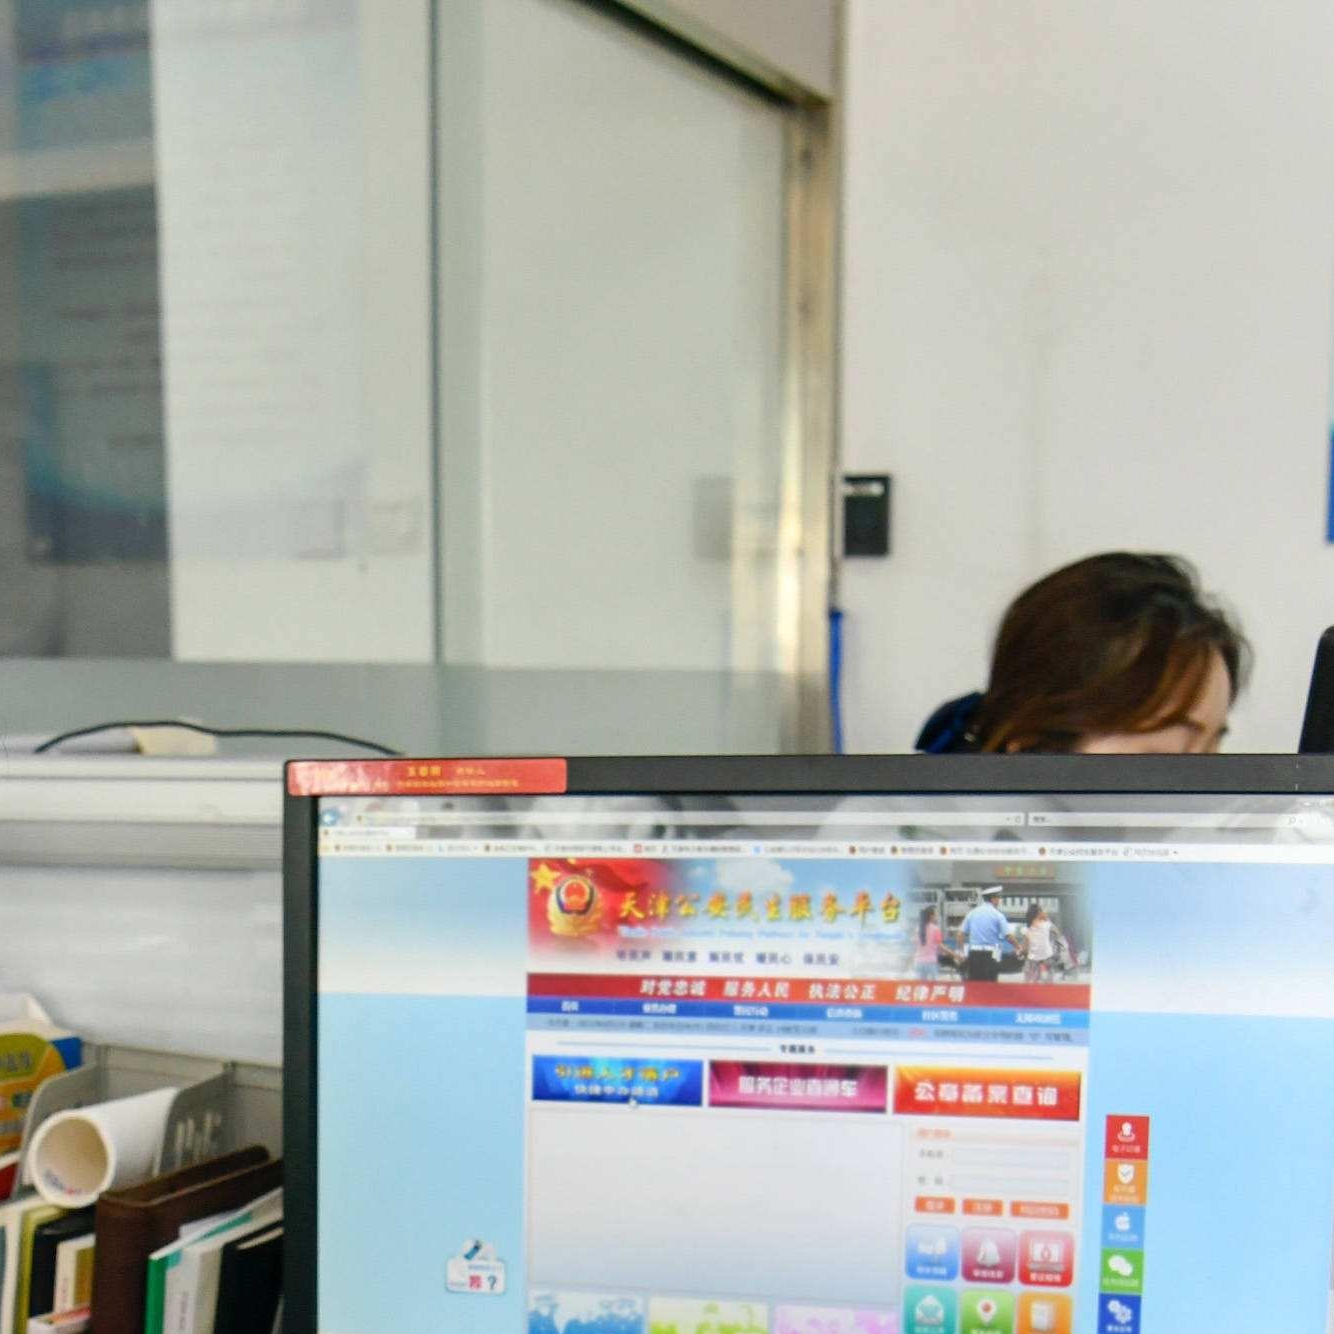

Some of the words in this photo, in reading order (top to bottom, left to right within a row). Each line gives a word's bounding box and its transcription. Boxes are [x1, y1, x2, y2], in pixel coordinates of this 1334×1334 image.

[619, 889, 902, 926] 天津公安民生服务平台
[640, 979, 706, 996] 对党忠诚
[723, 981, 789, 998] 服务人民
[809, 984, 876, 1000] 执法公正
[895, 985, 966, 1002] 纪律严明
[738, 1075, 858, 1098] 服务企业直通车
